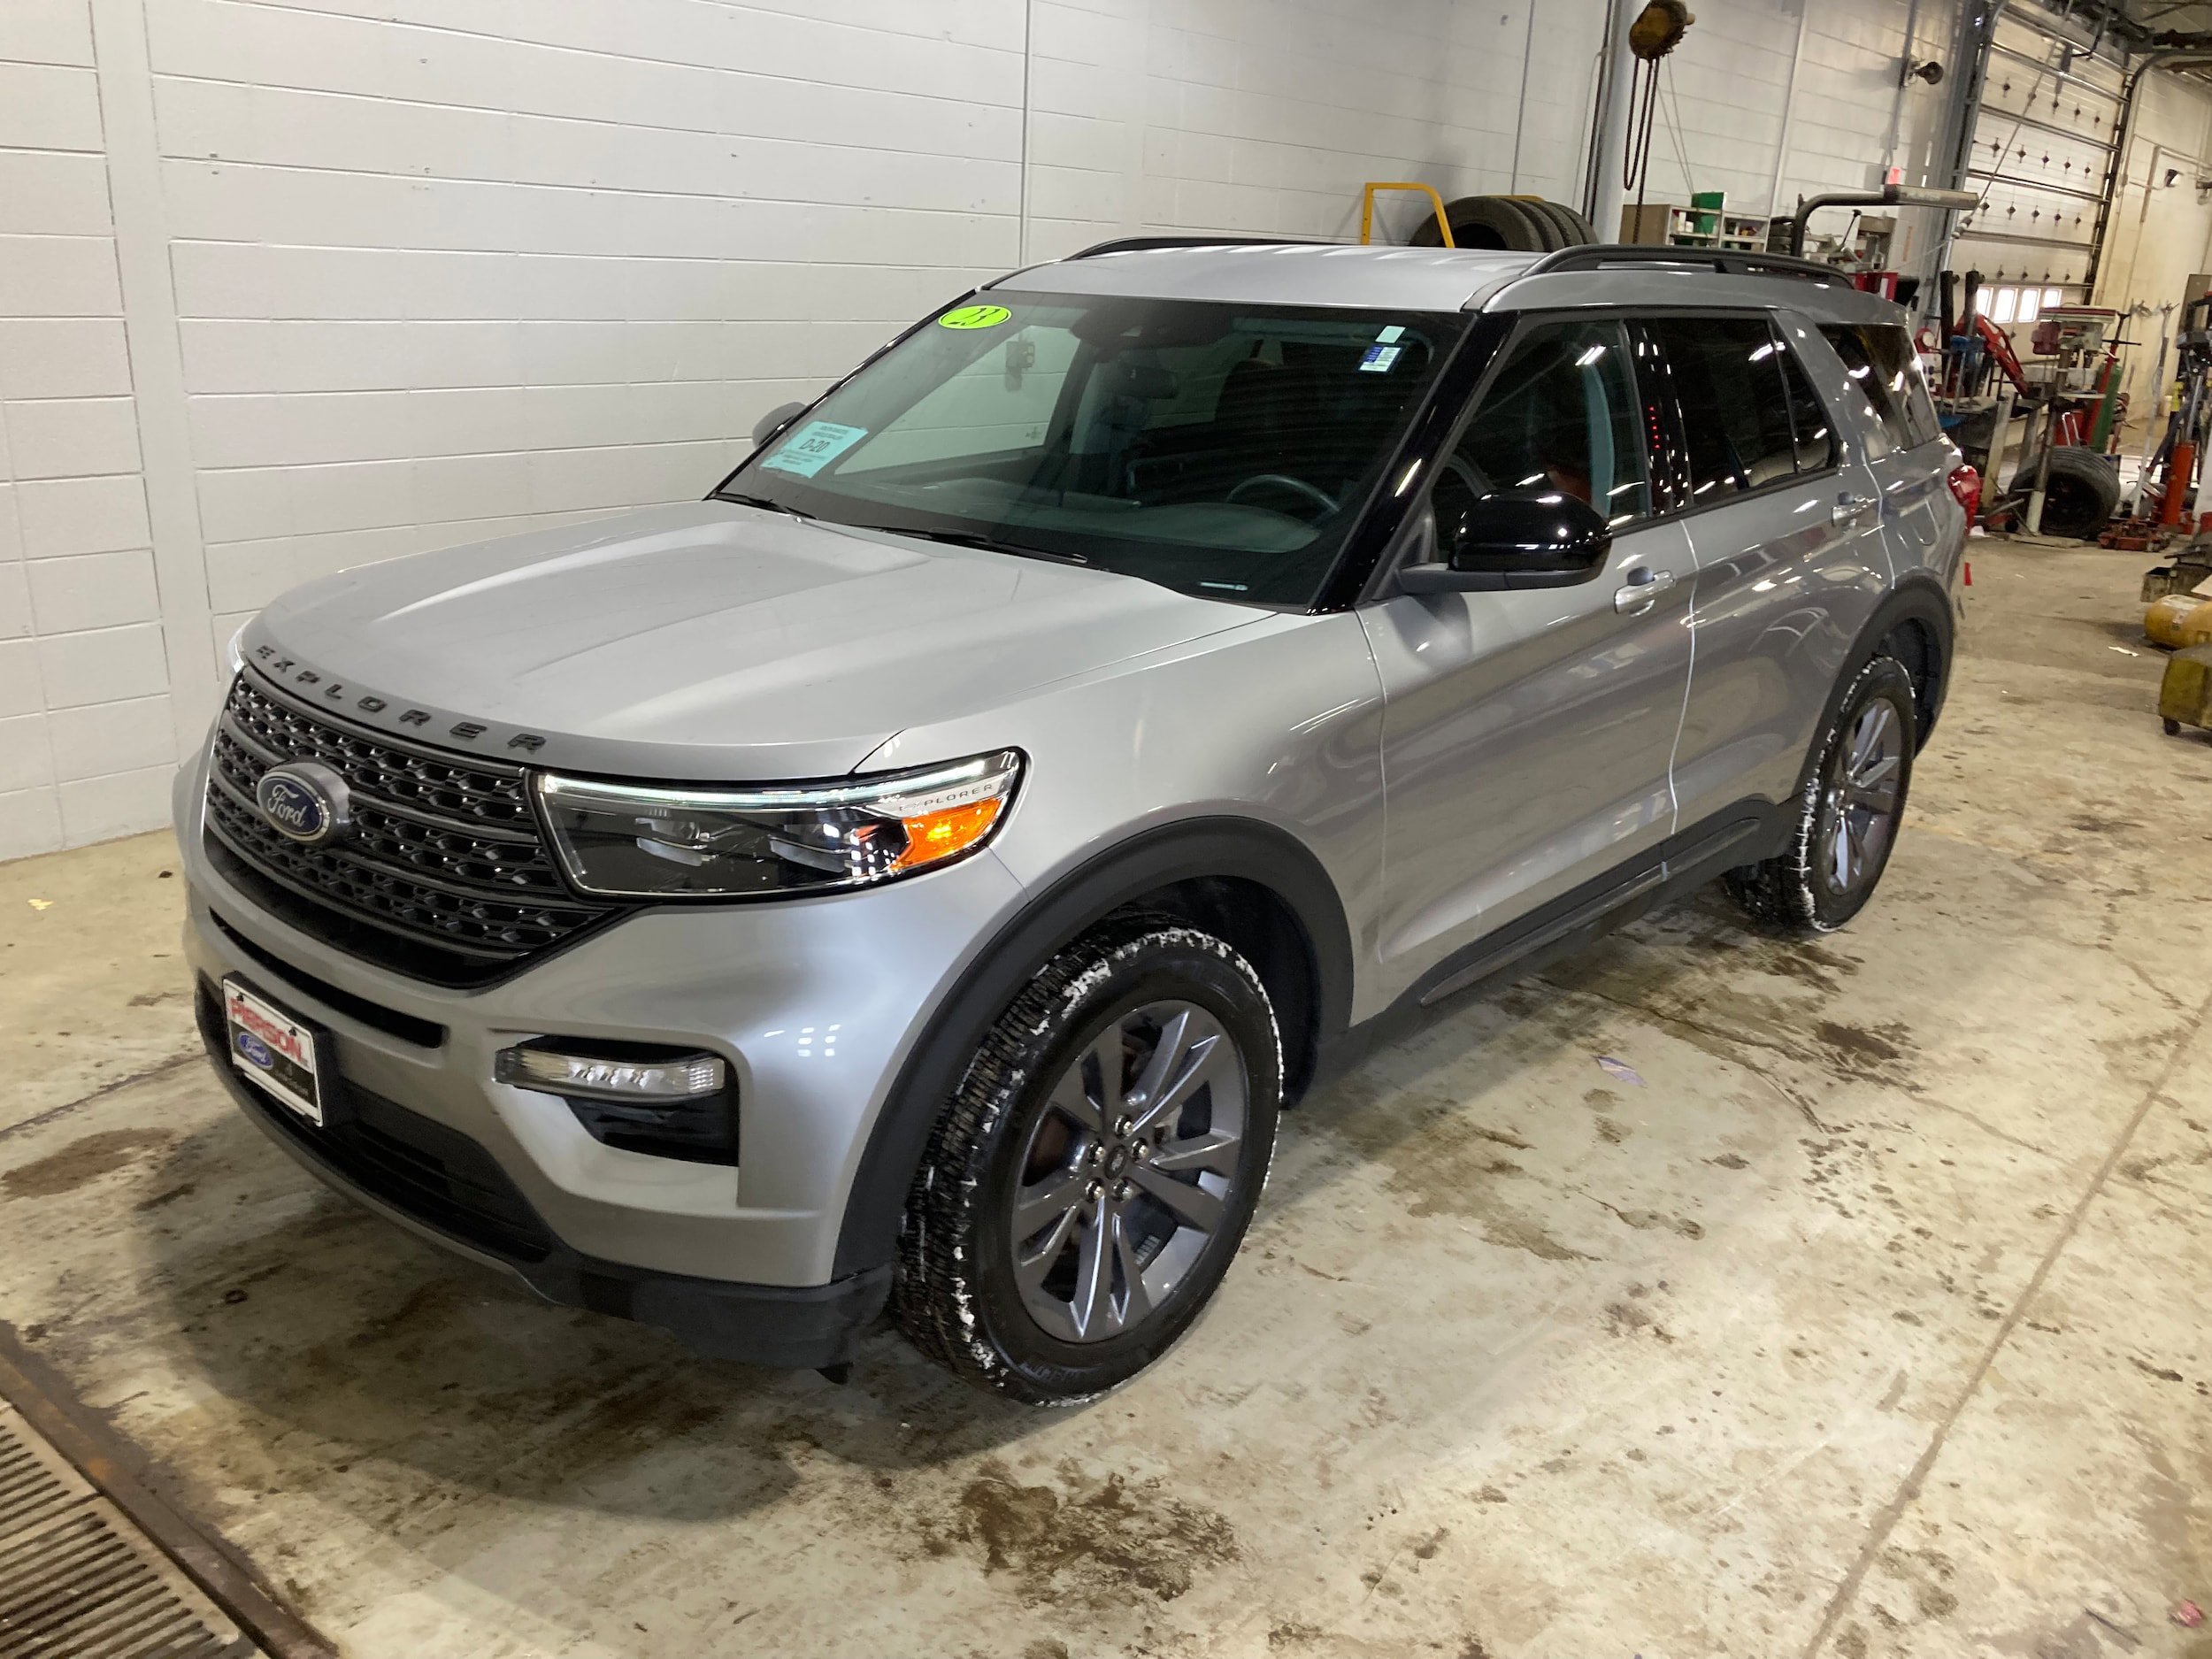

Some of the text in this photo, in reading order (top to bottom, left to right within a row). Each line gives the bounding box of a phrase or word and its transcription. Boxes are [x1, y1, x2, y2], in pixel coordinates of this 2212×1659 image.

[948, 307, 1001, 326] 23
[798, 438, 831, 453] D-20
[255, 644, 547, 755] EXPLORER
[267, 784, 307, 827] Ford
